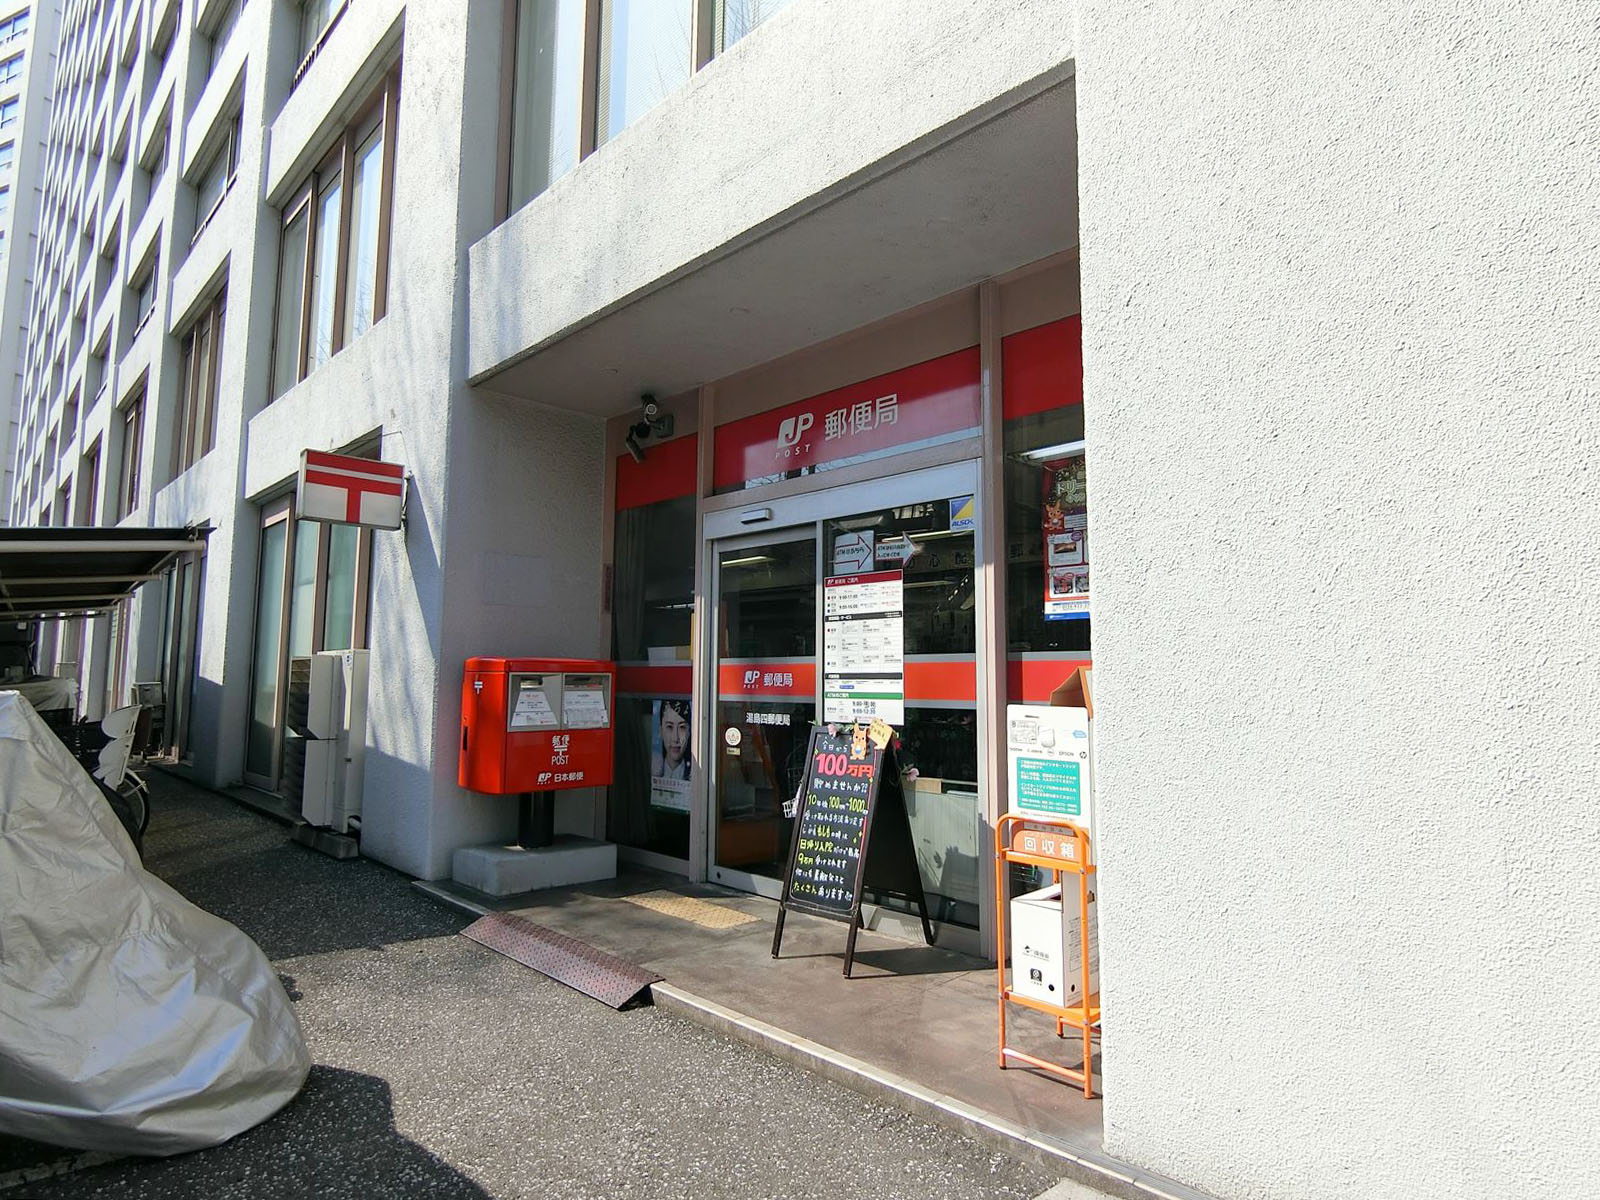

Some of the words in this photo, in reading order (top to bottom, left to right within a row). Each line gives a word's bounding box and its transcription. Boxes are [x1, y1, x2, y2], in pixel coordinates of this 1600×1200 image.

[825, 393, 899, 441] 郵便局
[775, 443, 811, 459] POST
[763, 672, 793, 688] 郵便局
[552, 734, 569, 746] 郵便
[551, 755, 569, 765] POST
[816, 753, 875, 778] 100万円
[554, 771, 585, 783] 日本郵便
[1023, 836, 1075, 859] 回収箱
